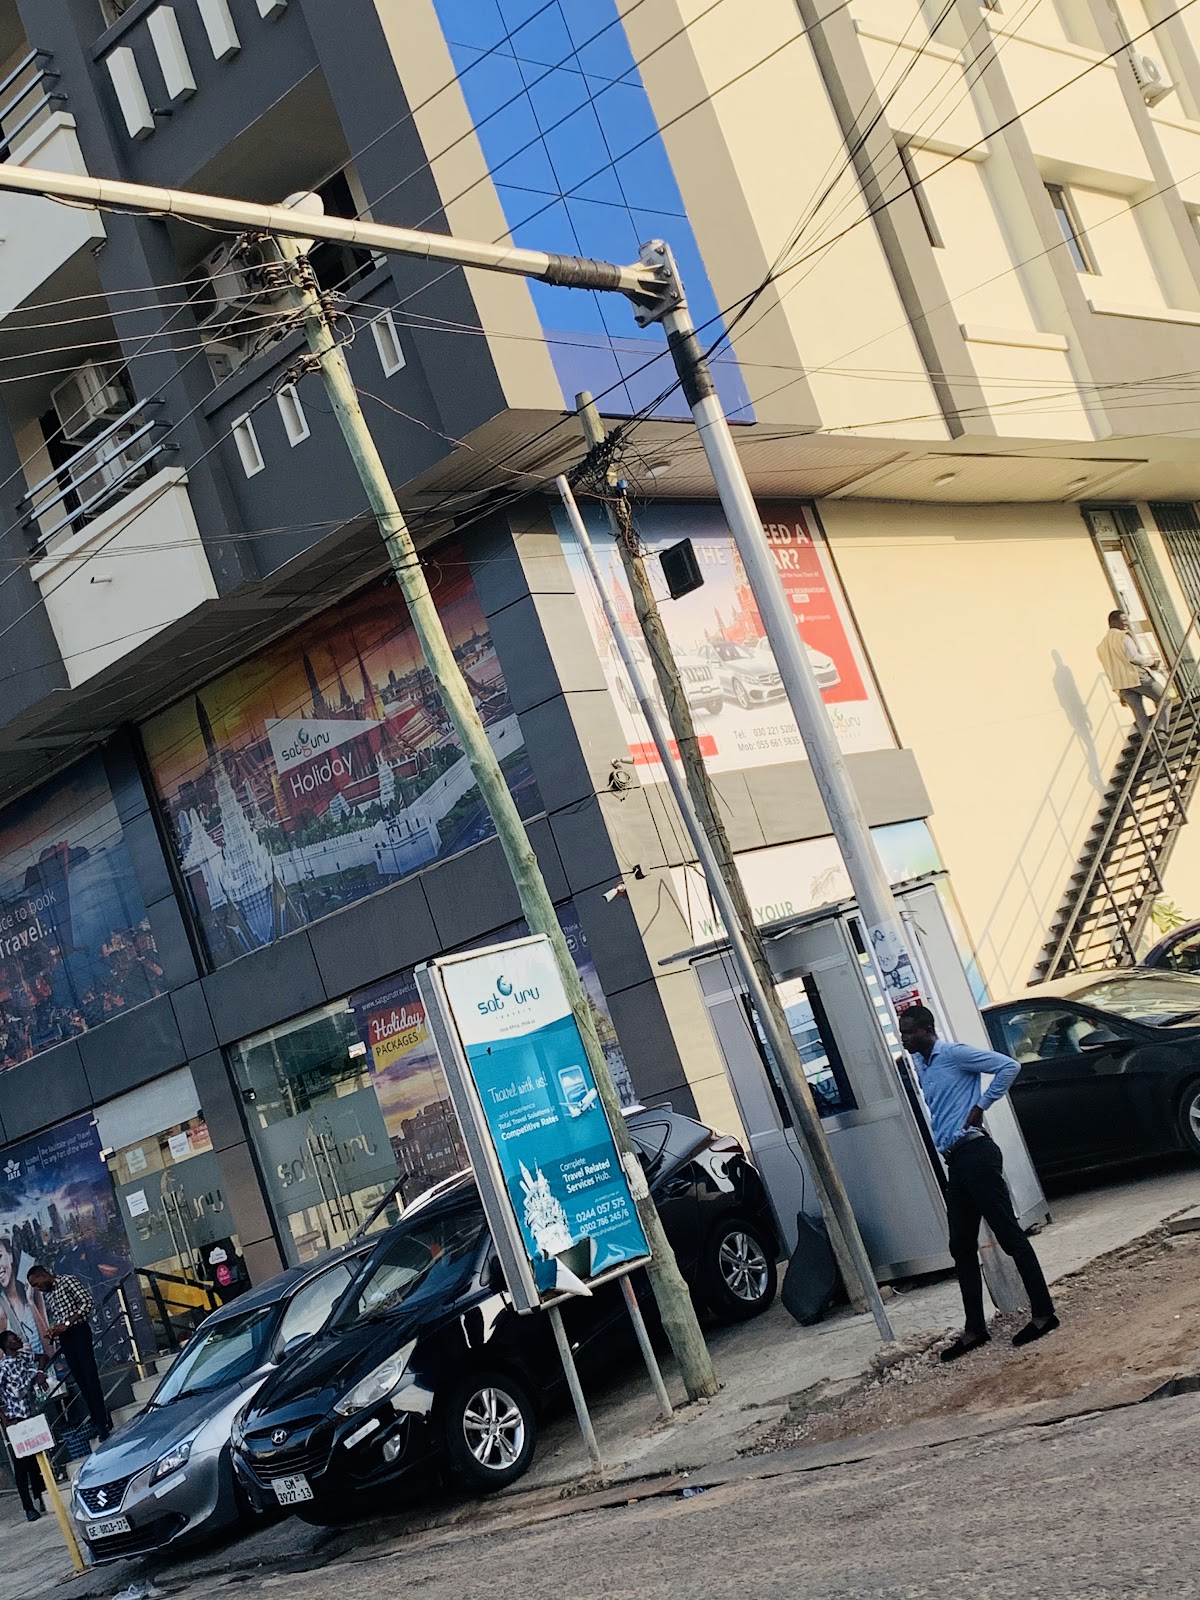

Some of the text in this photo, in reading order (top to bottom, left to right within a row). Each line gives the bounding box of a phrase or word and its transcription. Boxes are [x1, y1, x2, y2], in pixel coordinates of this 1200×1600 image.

[763, 523, 809, 545] EED A
[770, 549, 801, 570] AR?
[768, 725, 779, 736] 221
[757, 739, 771, 750] 055
[290, 752, 353, 798] Holiday
[15, 907, 28, 922] to
[28, 889, 57, 914] book
[755, 901, 796, 923] YOUR
[372, 1007, 423, 1040] Holiday
[376, 1032, 419, 1056] PACKAGES
[487, 1070, 548, 1104] Travel with us!
[498, 1120, 512, 1130] Total
[511, 1117, 527, 1126] Travel
[527, 1108, 551, 1120] Solutions
[501, 1114, 559, 1141] Competitive Rates
[7, 1169, 21, 1181] IATA
[560, 1157, 587, 1173] Complete
[562, 1158, 611, 1183] Travel Related
[566, 1177, 596, 1194] Services
[576, 1208, 597, 1223] 0244
[596, 1202, 611, 1214] 057
[611, 1196, 626, 1210] 575
[580, 1220, 597, 1235] 0302
[278, 1487, 312, 1504] 3927-13
[283, 1479, 297, 1490] GM
[89, 1526, 98, 1537] GE
